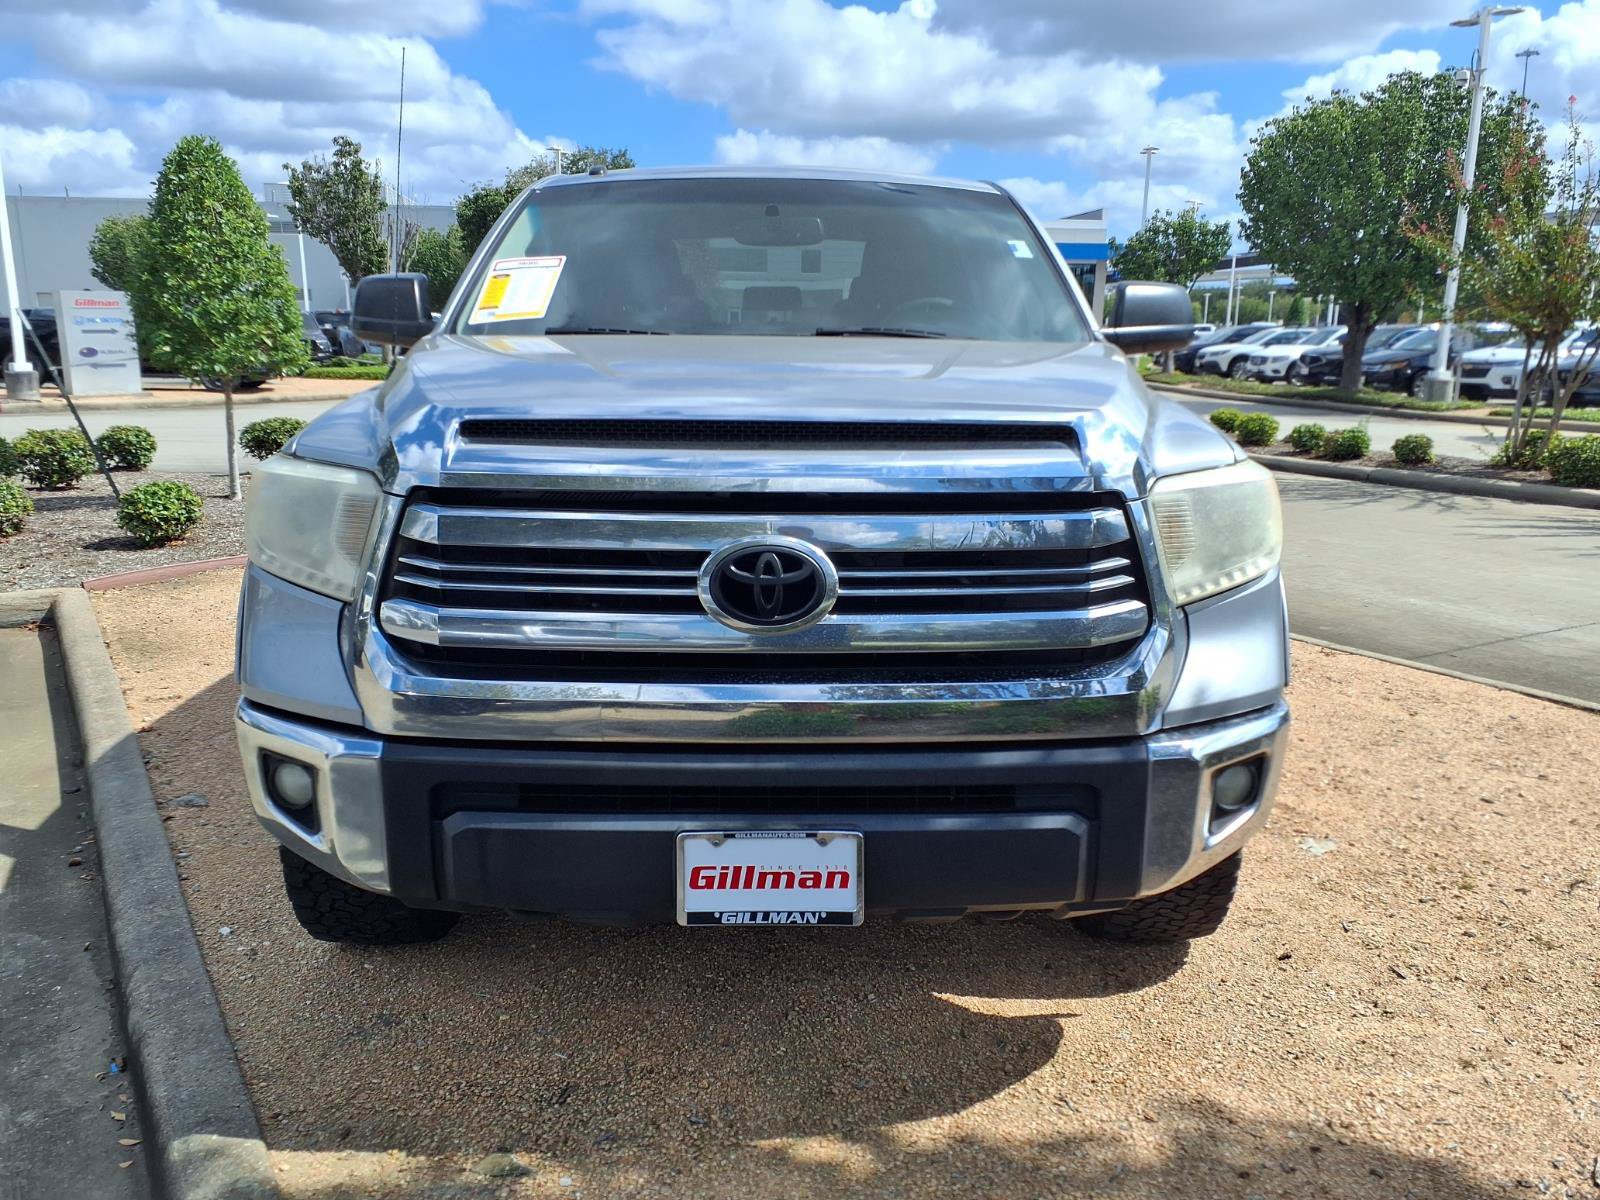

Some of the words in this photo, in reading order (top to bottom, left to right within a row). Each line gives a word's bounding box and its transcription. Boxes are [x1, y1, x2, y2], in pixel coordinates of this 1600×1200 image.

[75, 298, 119, 307] Gillman
[689, 866, 850, 890] Gillman
[721, 912, 819, 924] GILLMAN
